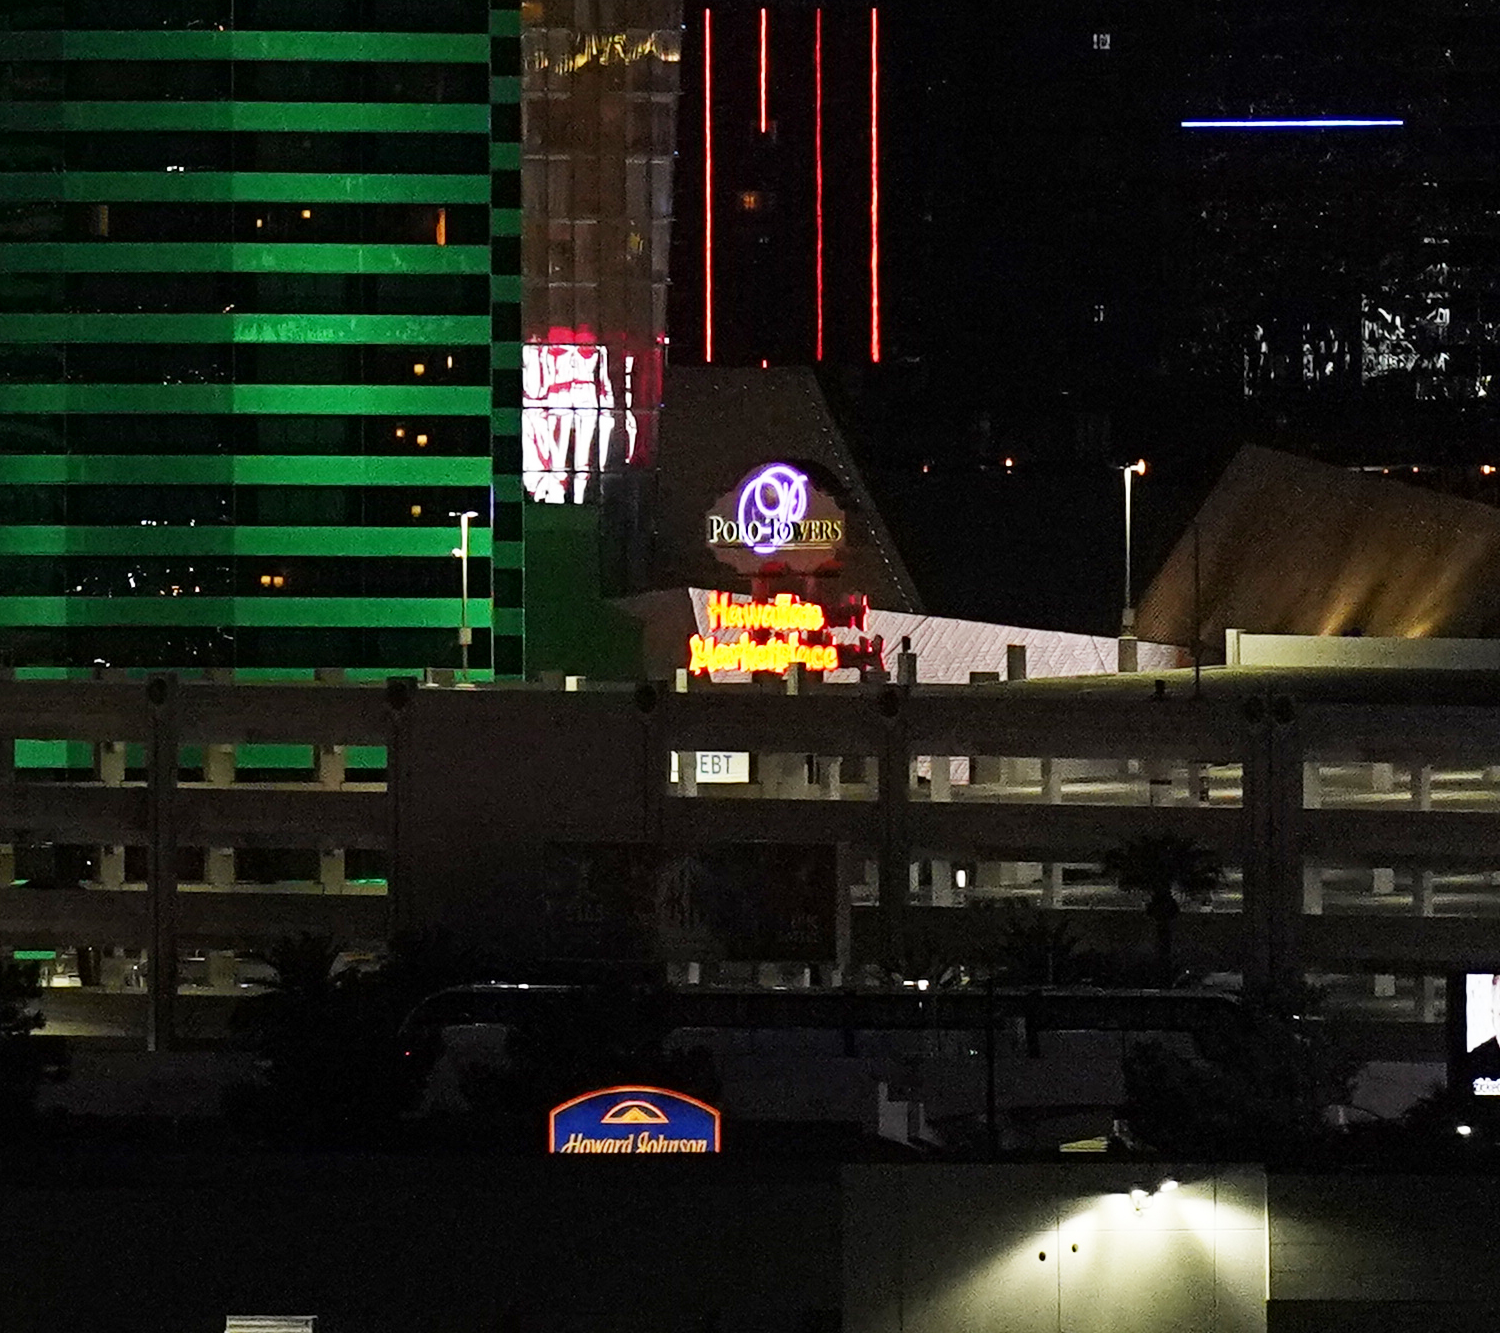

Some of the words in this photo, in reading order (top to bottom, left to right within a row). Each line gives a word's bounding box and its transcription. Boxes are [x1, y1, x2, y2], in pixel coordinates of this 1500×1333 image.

[700, 755, 733, 774] EBT
[560, 1133, 635, 1154] Howard
[635, 1132, 708, 1154] Johnson
